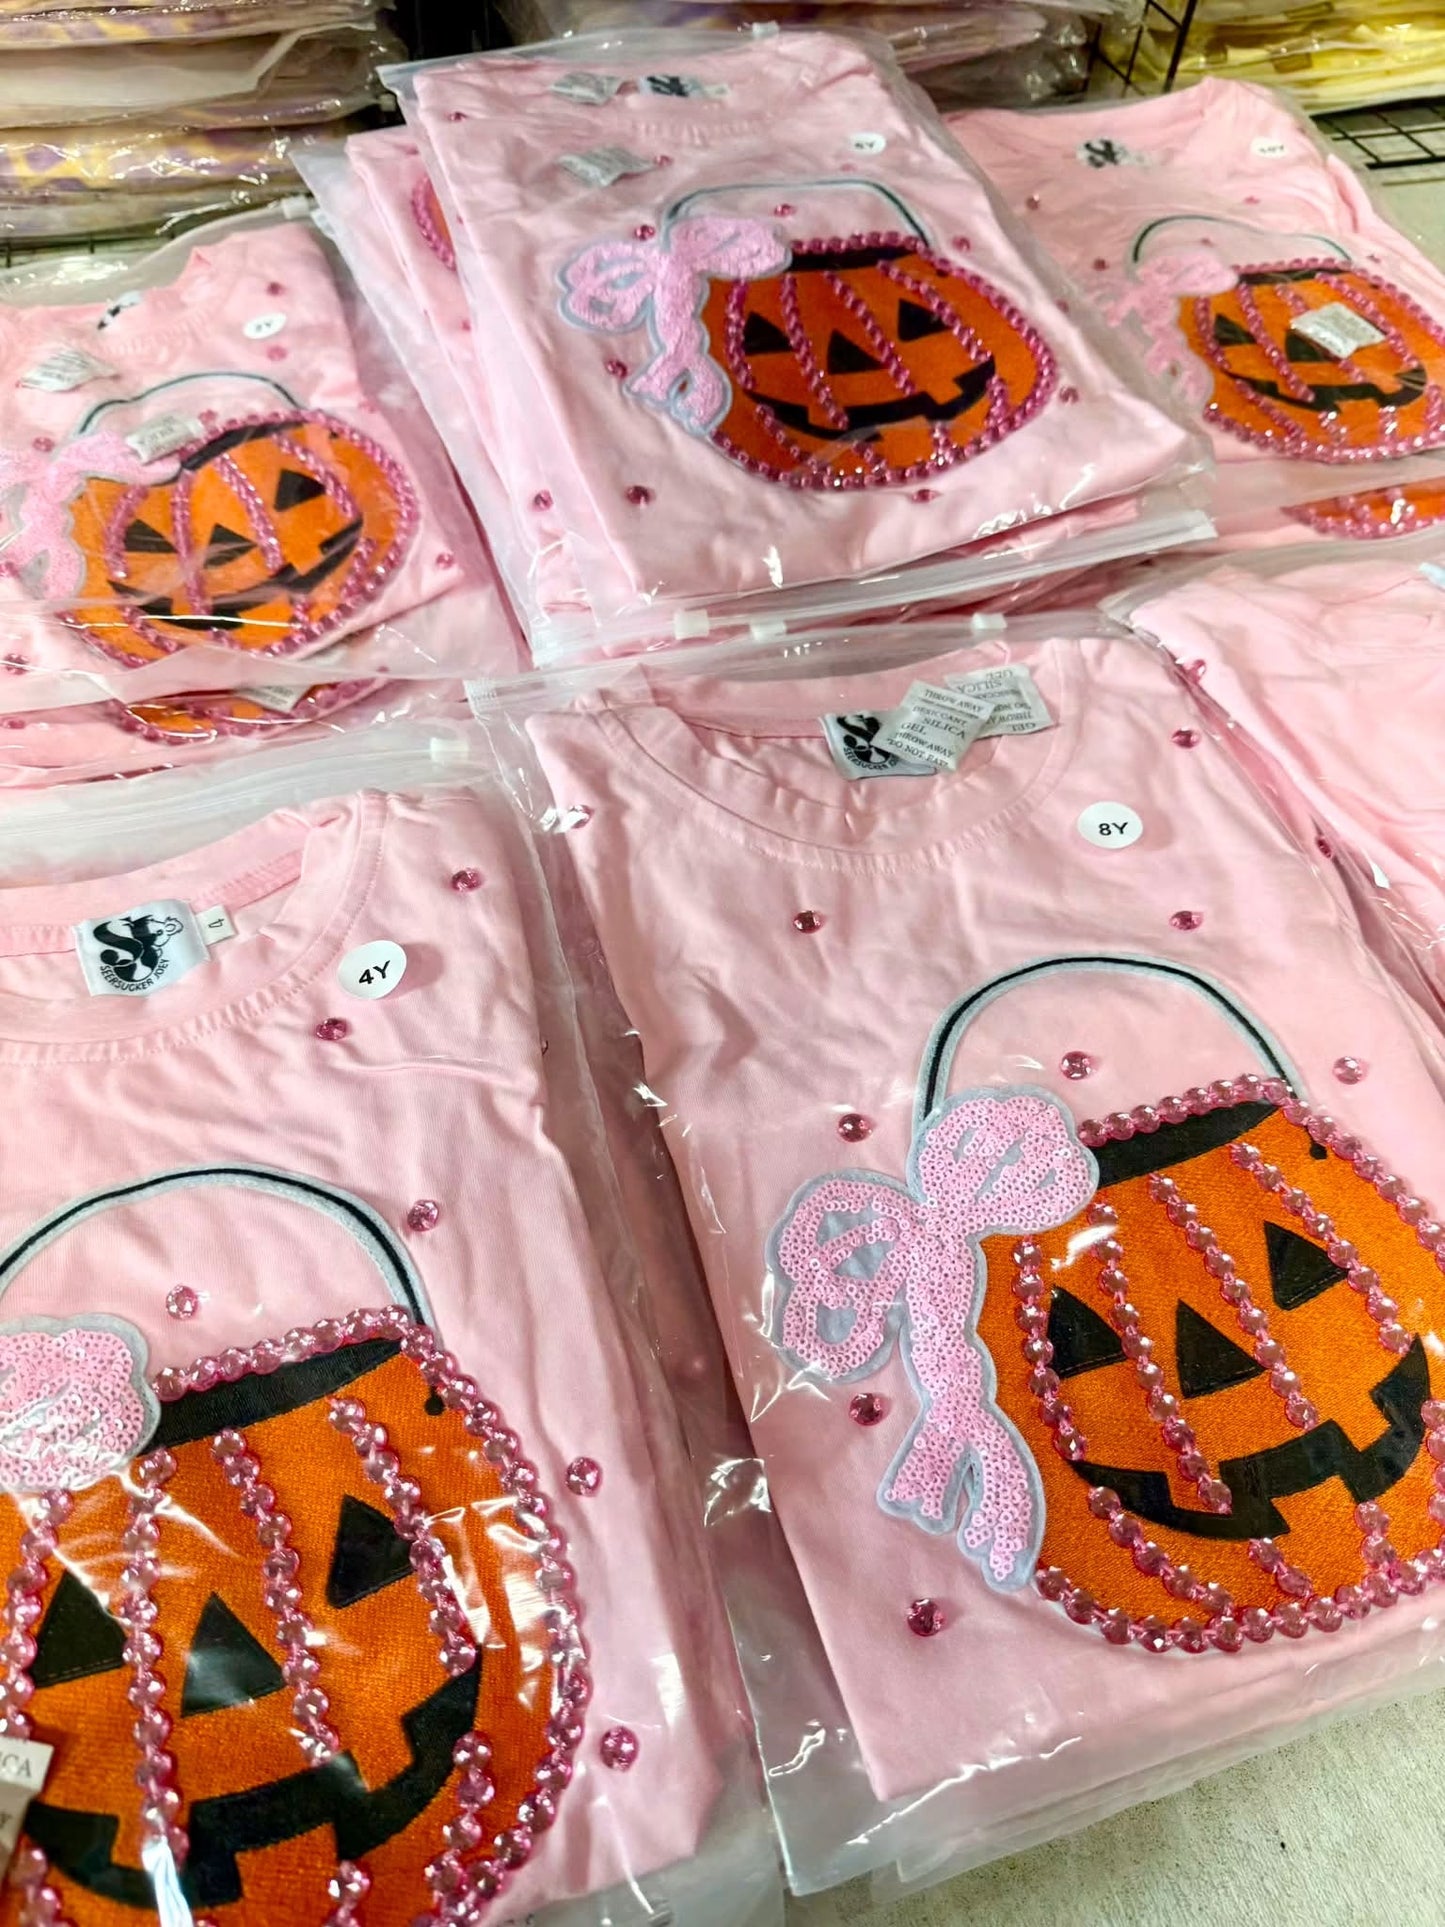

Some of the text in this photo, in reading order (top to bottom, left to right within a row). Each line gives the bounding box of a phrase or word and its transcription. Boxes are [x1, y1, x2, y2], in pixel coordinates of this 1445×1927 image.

[924, 689, 985, 713] THROW AWAY
[901, 722, 927, 736] GEL
[922, 717, 966, 739] SILICA
[904, 745, 926, 758] NOT
[926, 743, 955, 758] AWAY
[1098, 821, 1129, 837] 8Y
[99, 958, 170, 992] SEERSUCKER JOEY
[358, 959, 391, 986] 4Y
